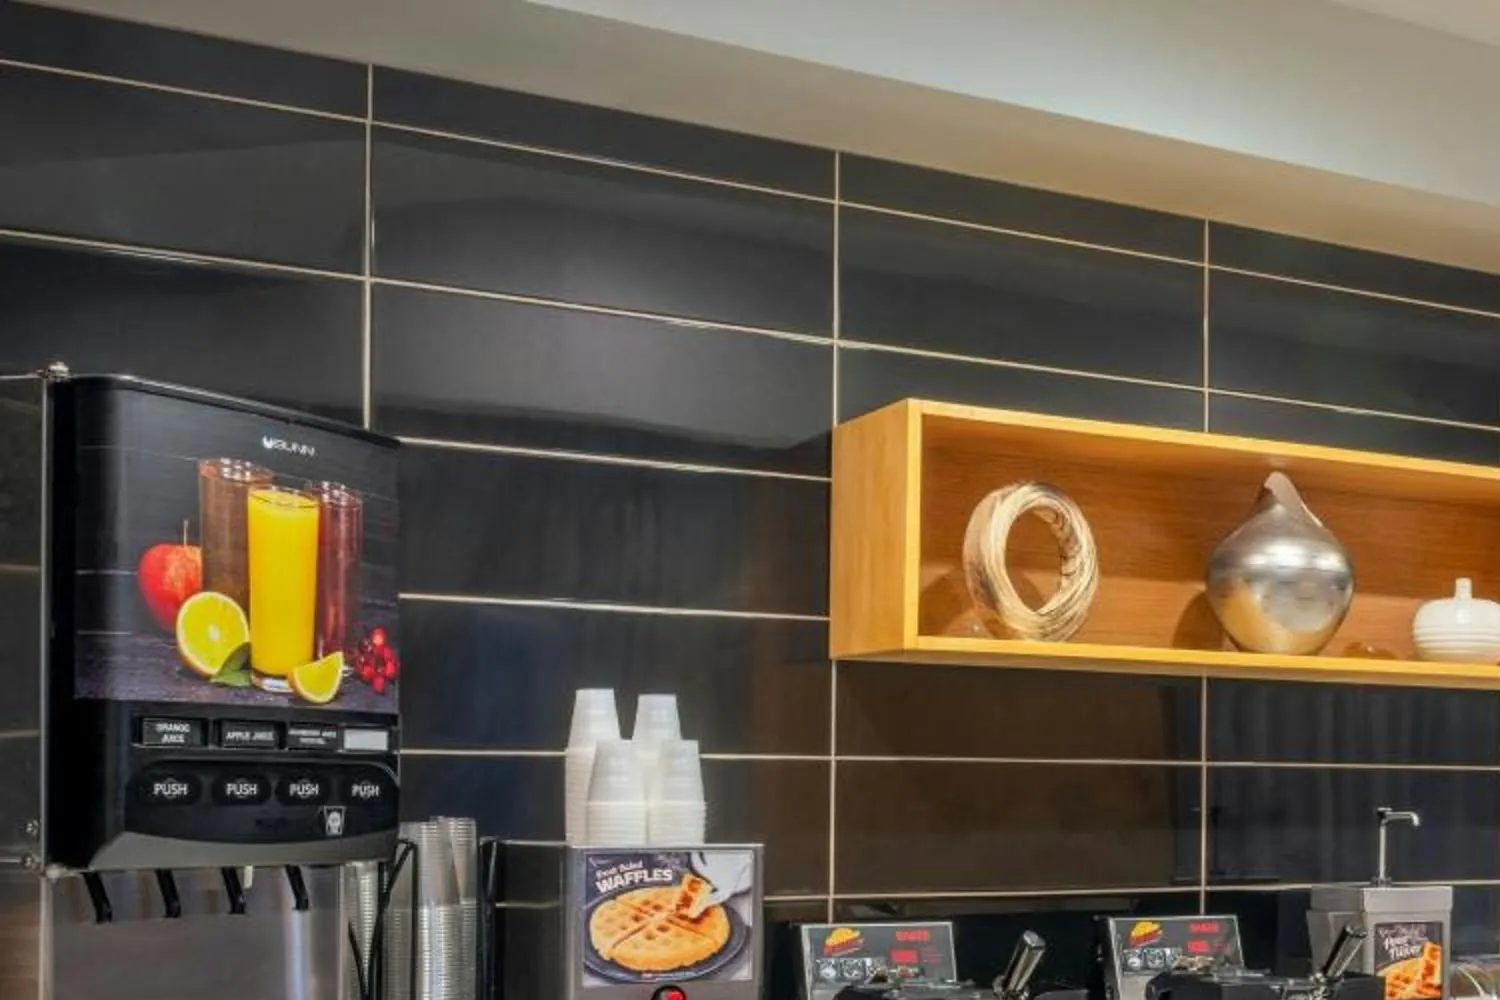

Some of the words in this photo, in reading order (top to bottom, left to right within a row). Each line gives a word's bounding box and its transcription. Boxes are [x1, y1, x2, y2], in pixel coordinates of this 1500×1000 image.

[225, 731, 251, 742] APPLE
[153, 783, 188, 796] PUSH
[227, 783, 258, 796] PUSH
[289, 783, 320, 797] PUSH
[351, 784, 380, 797] PUSH
[595, 868, 673, 893] WAFFLES
